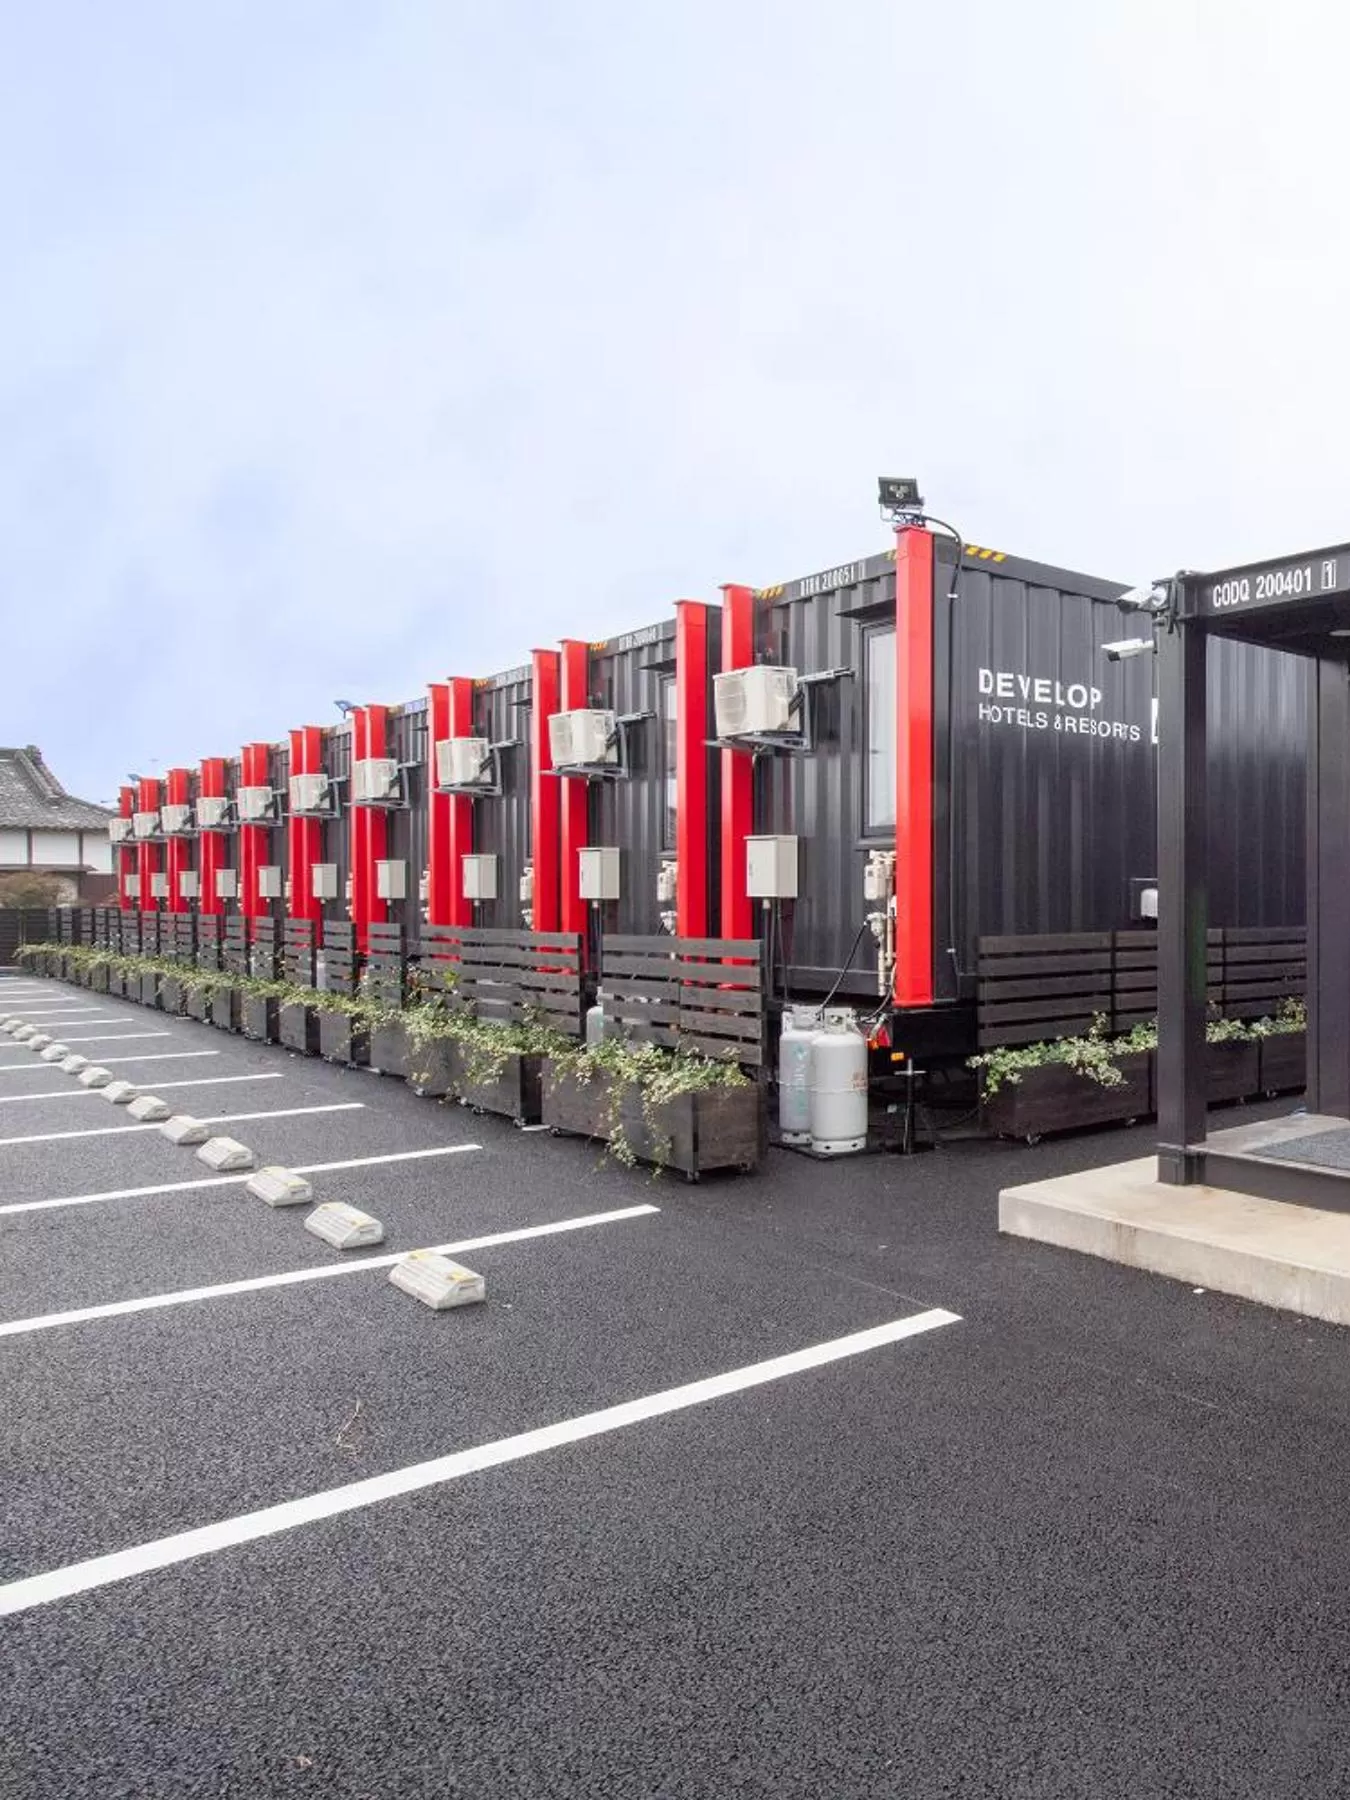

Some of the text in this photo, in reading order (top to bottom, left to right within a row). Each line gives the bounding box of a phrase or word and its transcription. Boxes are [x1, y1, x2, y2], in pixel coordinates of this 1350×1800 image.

[1212, 578, 1250, 608] CODQ
[1255, 566, 1312, 599] 200401
[978, 667, 1103, 710] DEVELOP
[978, 702, 1048, 729] HOTELS
